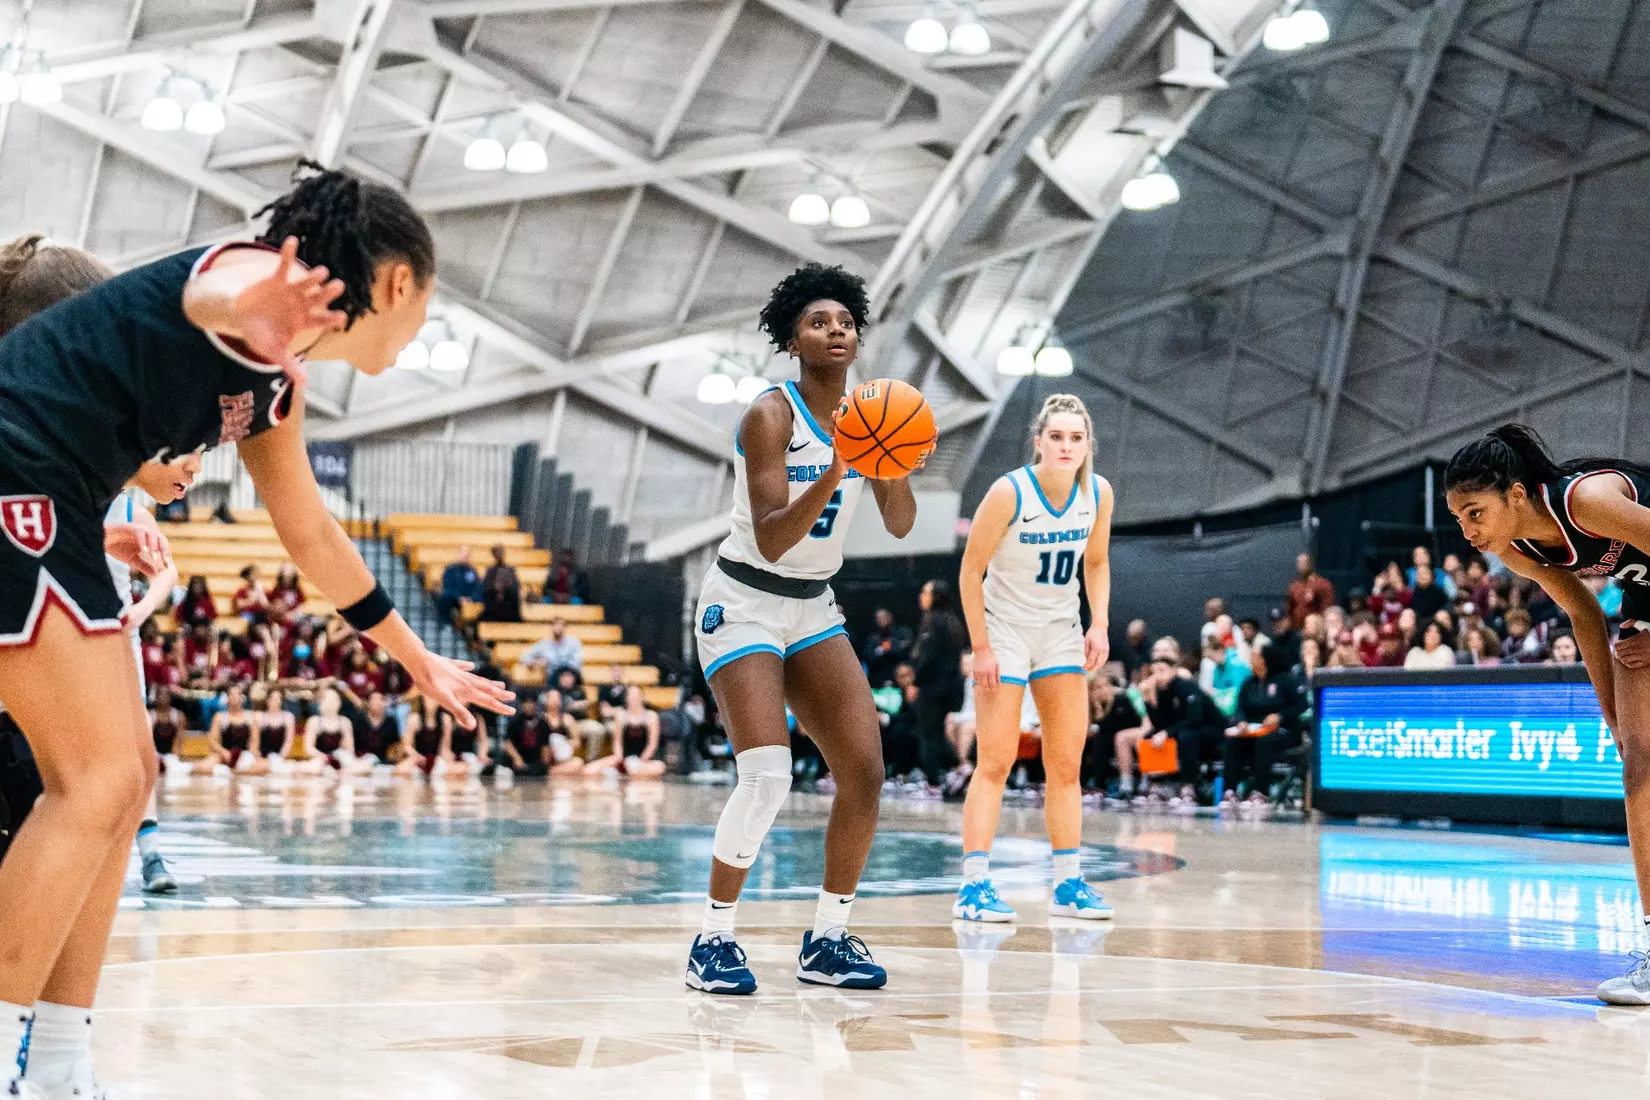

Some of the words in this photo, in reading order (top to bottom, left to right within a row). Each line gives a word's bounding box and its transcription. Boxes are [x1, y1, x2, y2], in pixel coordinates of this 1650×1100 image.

[11, 502, 46, 541] H
[808, 488, 843, 539] 5
[1035, 549, 1075, 586] 10
[1328, 719, 1498, 760] TicketSmarter
